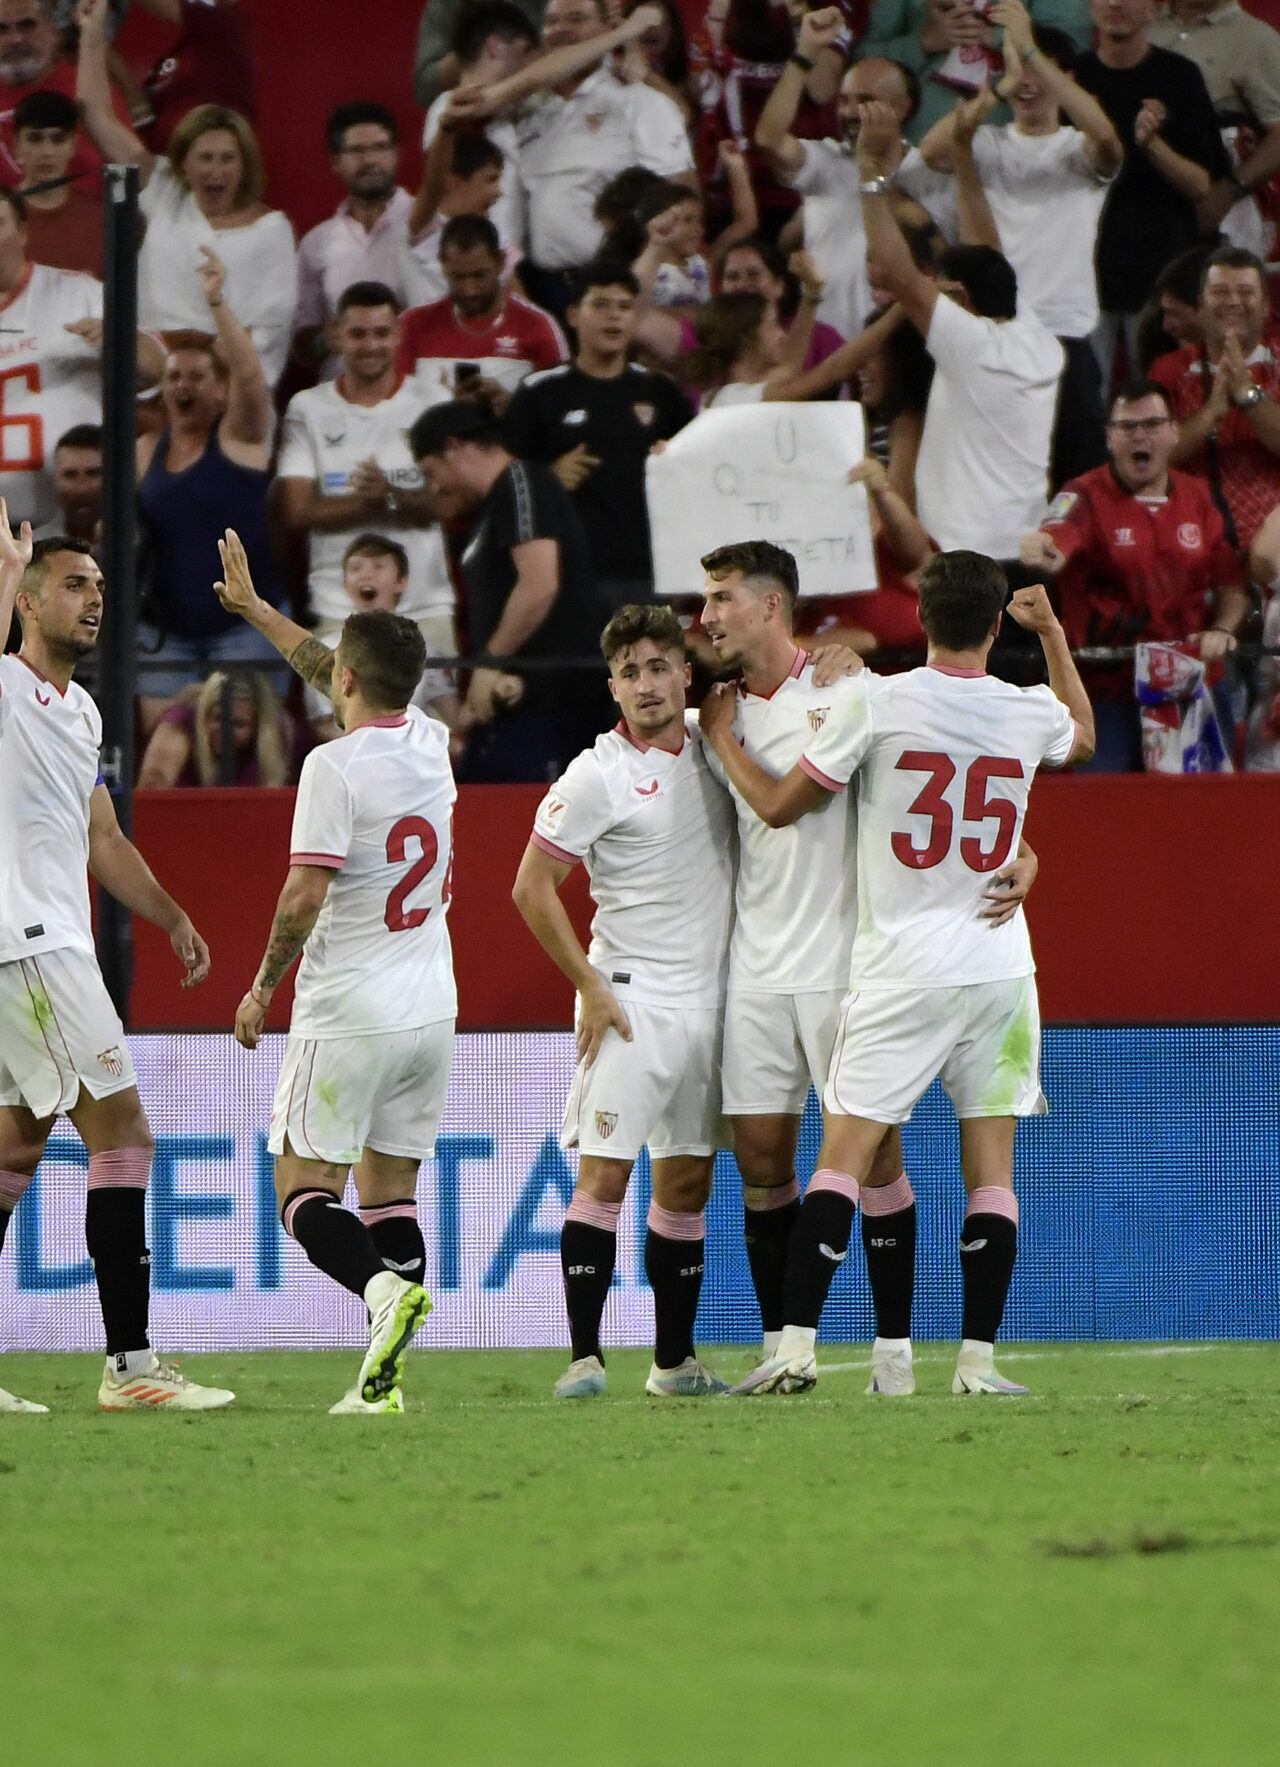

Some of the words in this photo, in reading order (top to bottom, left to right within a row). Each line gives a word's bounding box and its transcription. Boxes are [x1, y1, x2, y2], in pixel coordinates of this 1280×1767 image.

[745, 501, 780, 523] TU
[891, 750, 1024, 873] 35
[870, 1238, 897, 1248] SFC
[568, 1265, 596, 1276] SFC
